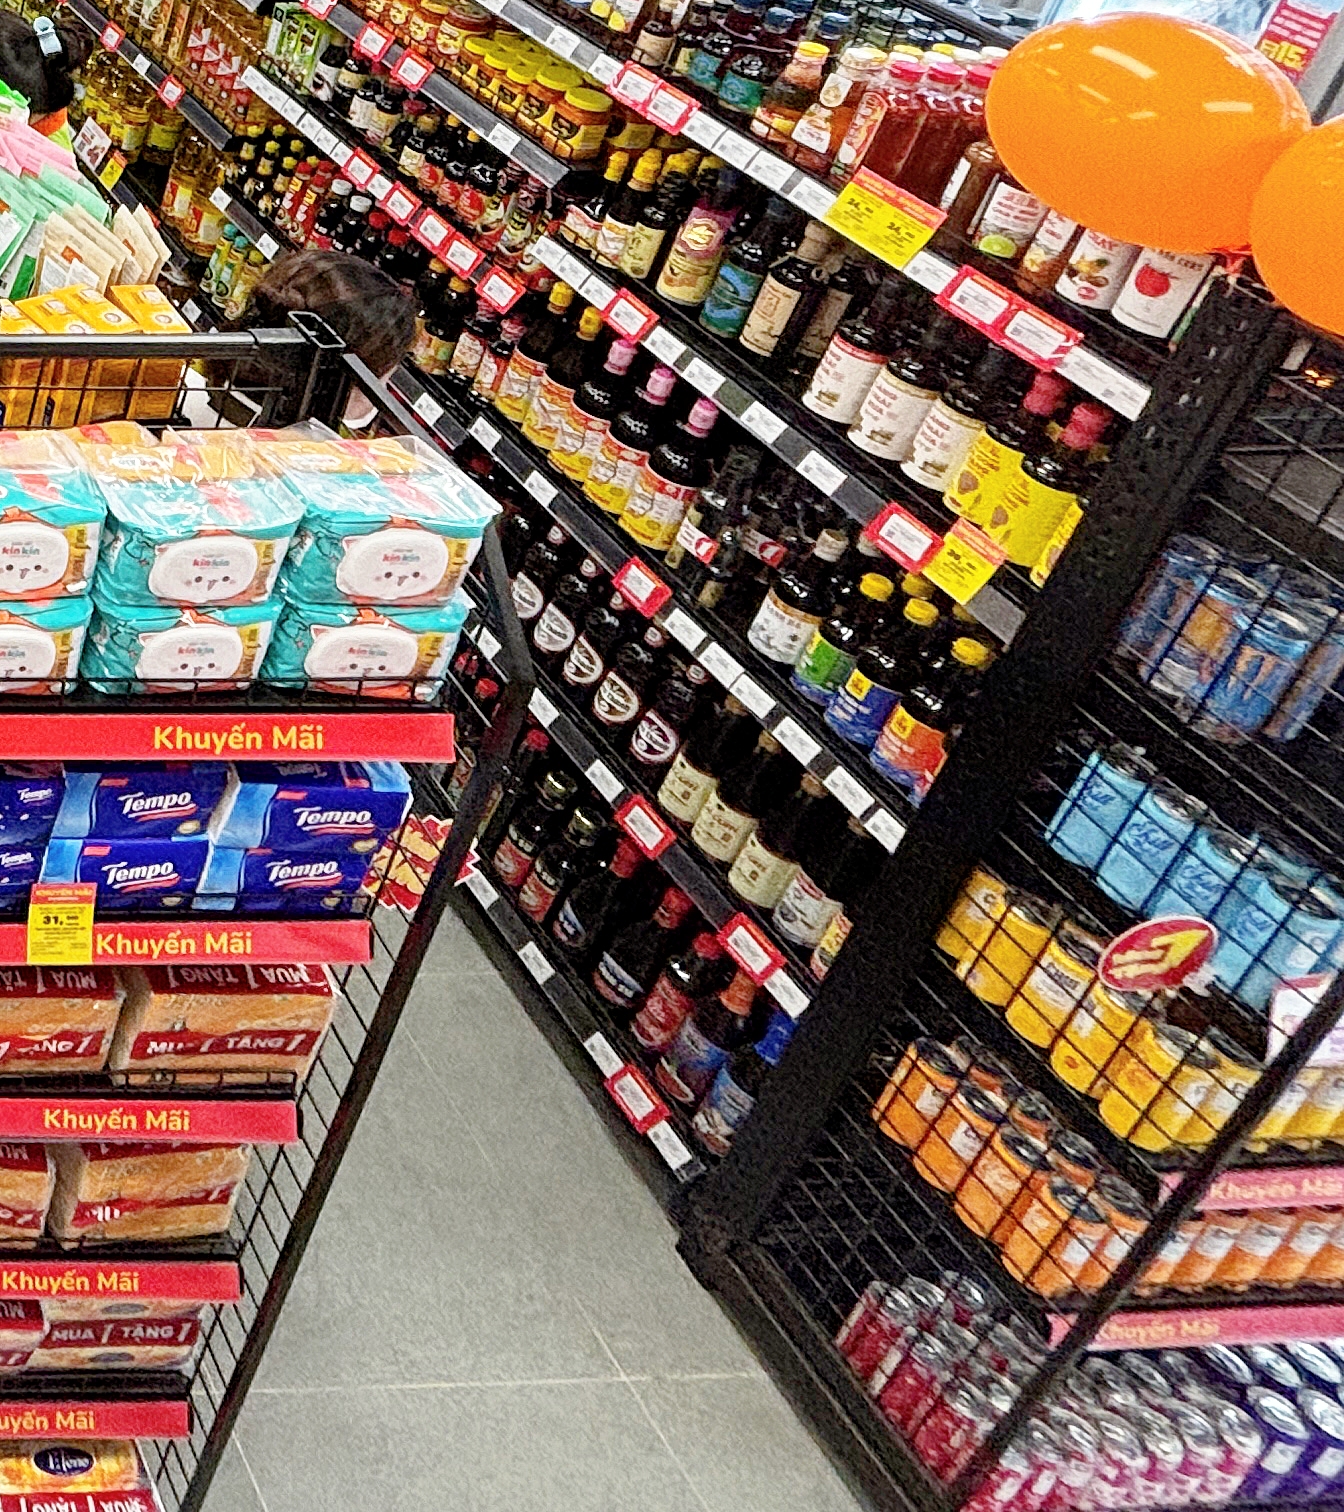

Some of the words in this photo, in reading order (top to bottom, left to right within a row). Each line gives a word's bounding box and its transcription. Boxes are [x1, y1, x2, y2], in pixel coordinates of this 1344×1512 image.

[153, 724, 262, 756] Khuyến
[273, 724, 324, 750] Mãi
[118, 789, 193, 816] Tempo
[293, 806, 372, 831] Tempo
[101, 859, 175, 887] Tempo
[266, 858, 339, 885] Tempo
[95, 928, 198, 963] Khuyến
[44, 1106, 137, 1135] Khuyến
[51, 1328, 95, 1342] MUA
[123, 1324, 175, 1343] TẶNG
